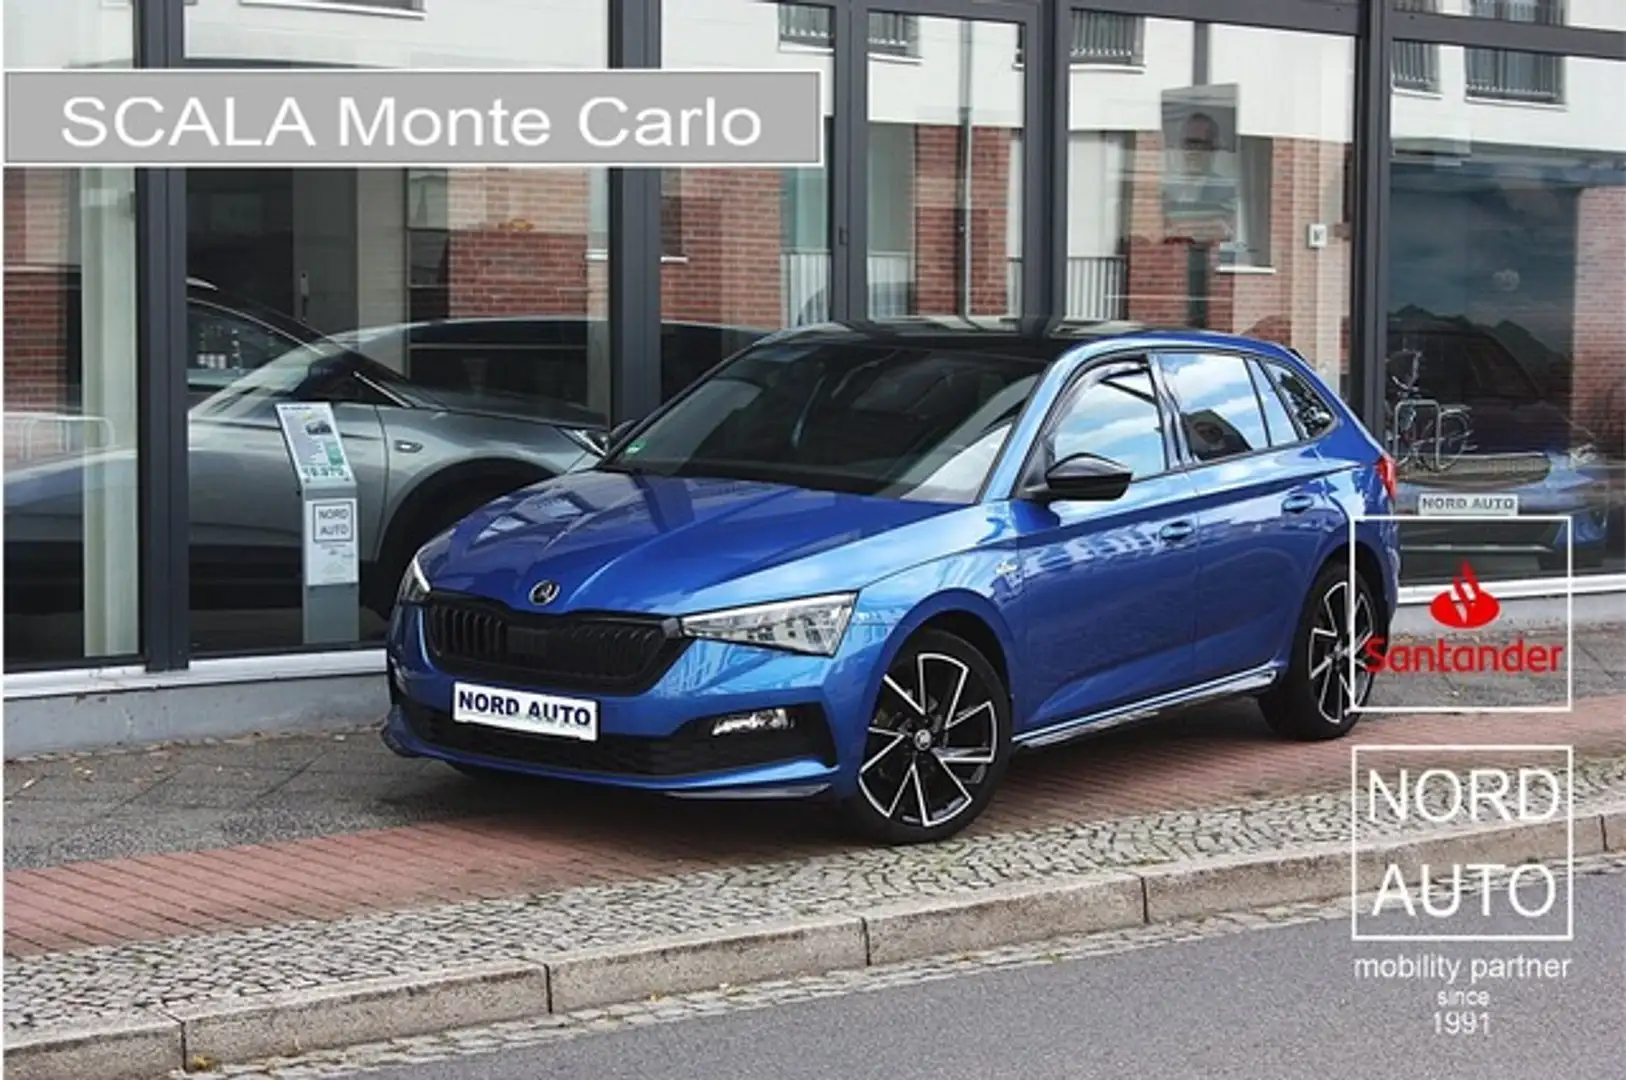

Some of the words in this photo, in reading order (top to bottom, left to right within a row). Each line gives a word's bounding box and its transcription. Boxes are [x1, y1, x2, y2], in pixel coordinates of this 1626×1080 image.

[1422, 498, 1467, 509] NORD
[1472, 498, 1515, 509] AUTO
[318, 509, 348, 519] NORD
[320, 526, 348, 536] AUTO
[459, 690, 519, 716] NORD
[528, 701, 591, 726] AUTO
